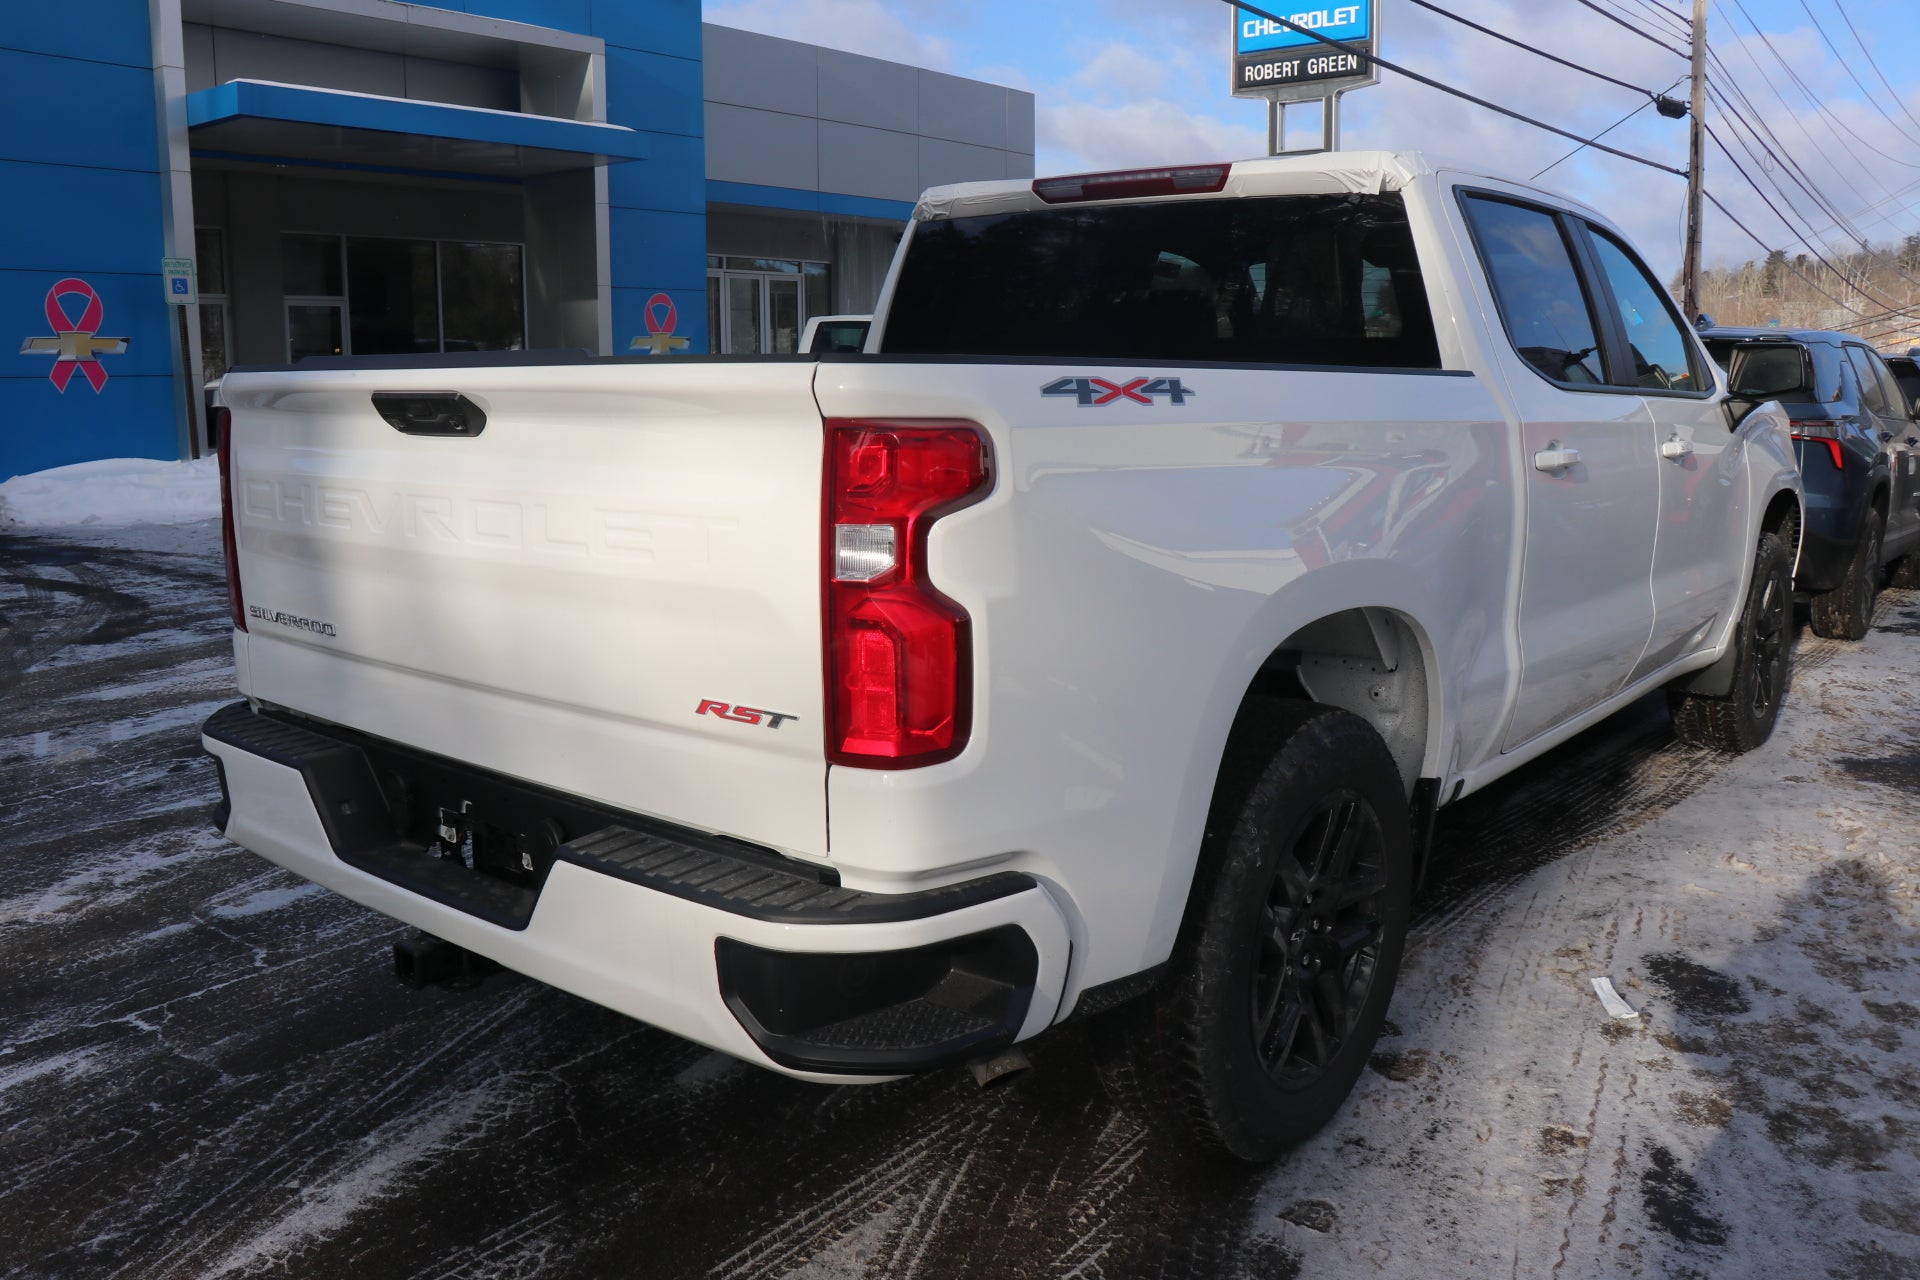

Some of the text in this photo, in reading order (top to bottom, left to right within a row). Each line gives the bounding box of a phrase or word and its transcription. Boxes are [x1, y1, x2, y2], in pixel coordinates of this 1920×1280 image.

[1245, 54, 1357, 82] ROBERT GREEN
[242, 476, 739, 568] CHEVROLET
[249, 605, 336, 637] SILVERADO
[695, 698, 799, 729] RST
